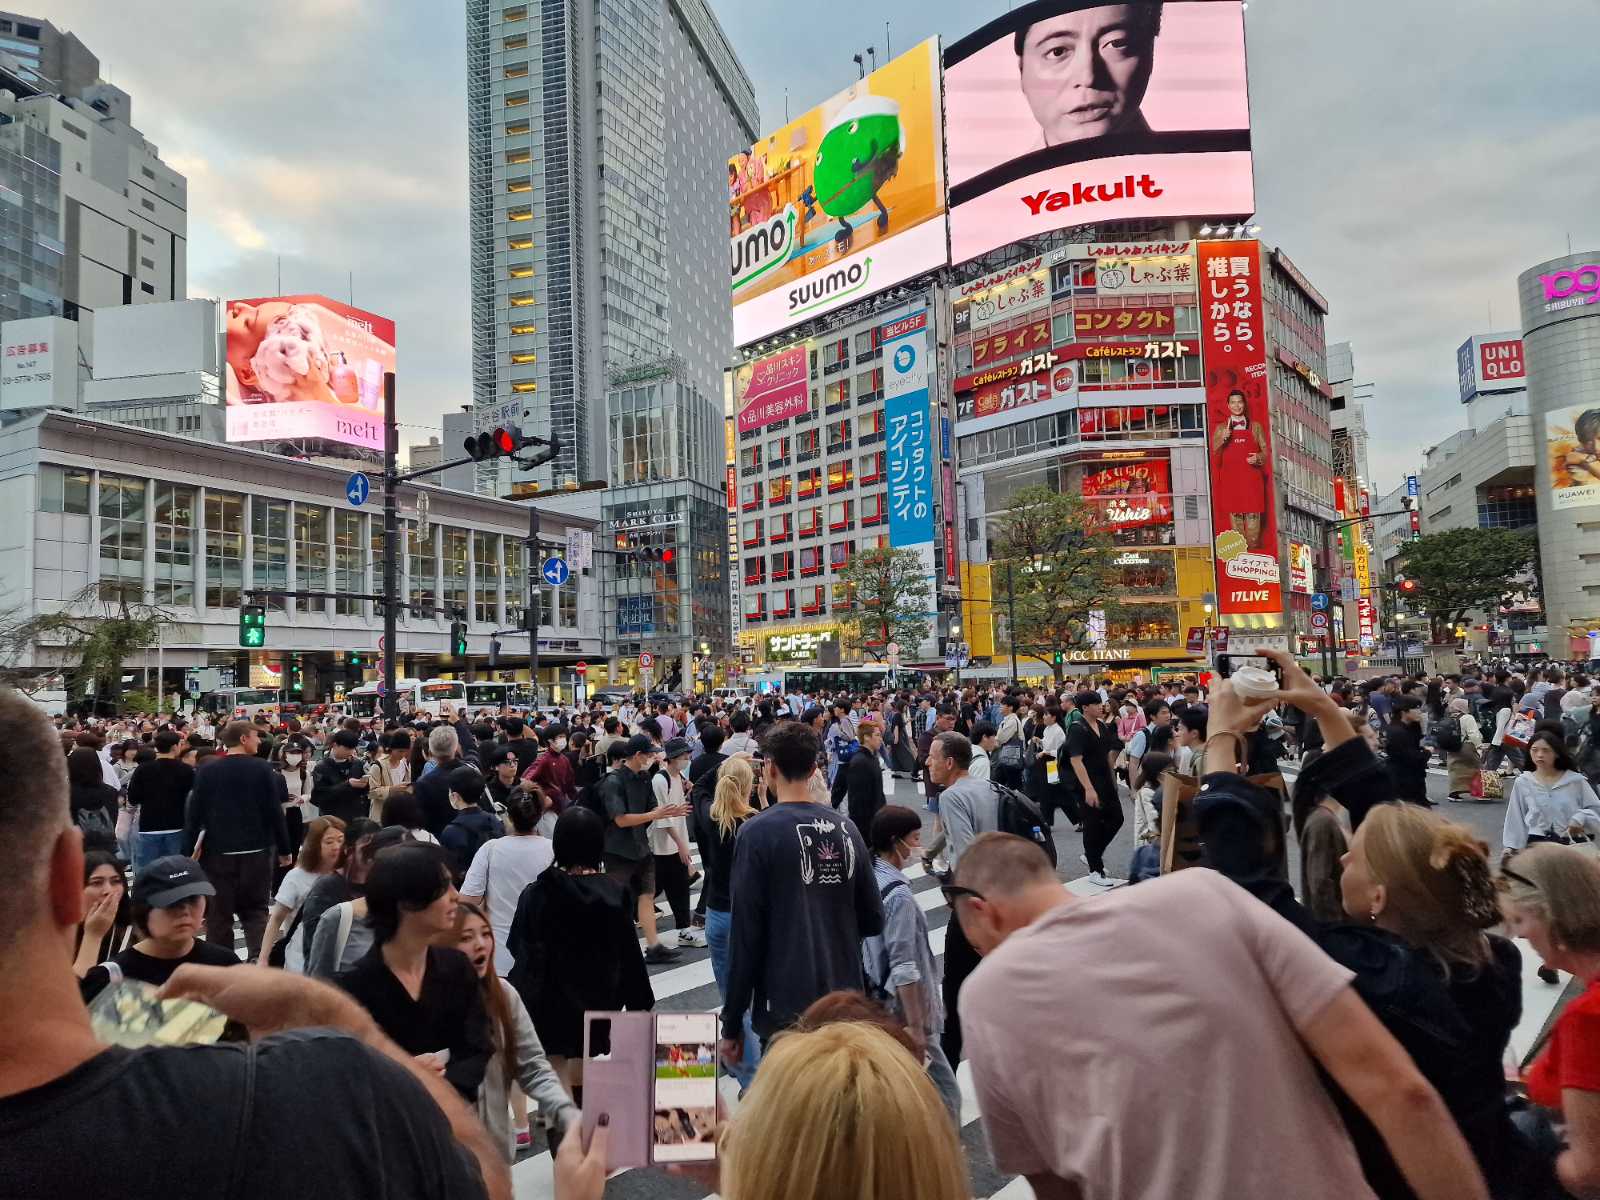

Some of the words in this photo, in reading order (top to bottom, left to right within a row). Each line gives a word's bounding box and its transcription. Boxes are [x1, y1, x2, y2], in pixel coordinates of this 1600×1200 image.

[1021, 174, 1163, 217] Yakult
[1130, 262, 1191, 283] しゃぶ葉
[997, 280, 1045, 310] しゃぶ葉
[1206, 257, 1232, 353] 推しから。
[1229, 256, 1255, 351] 買うなら、
[1545, 297, 1584, 312] SHIBUYA
[955, 310, 969, 324] 9F
[1075, 310, 1171, 330] コンタクト
[1144, 341, 1190, 358] ガスト
[1485, 345, 1518, 359] UNI
[1020, 351, 1058, 376] ガスト
[1486, 359, 1521, 377] QLO
[1000, 380, 1047, 409] ガスト
[747, 394, 803, 425] 品川美容外科
[957, 400, 974, 415] 7F
[337, 420, 378, 440] melt
[890, 416, 910, 521] アイシティ
[911, 410, 927, 519] コンタクトの
[1558, 488, 1595, 499] HUAWEI
[609, 518, 647, 529] MARK
[652, 513, 684, 523] CITY
[626, 508, 664, 518] SHIBUYA
[1232, 565, 1277, 577] SHOPPING!
[1231, 590, 1269, 603] 17LIVE
